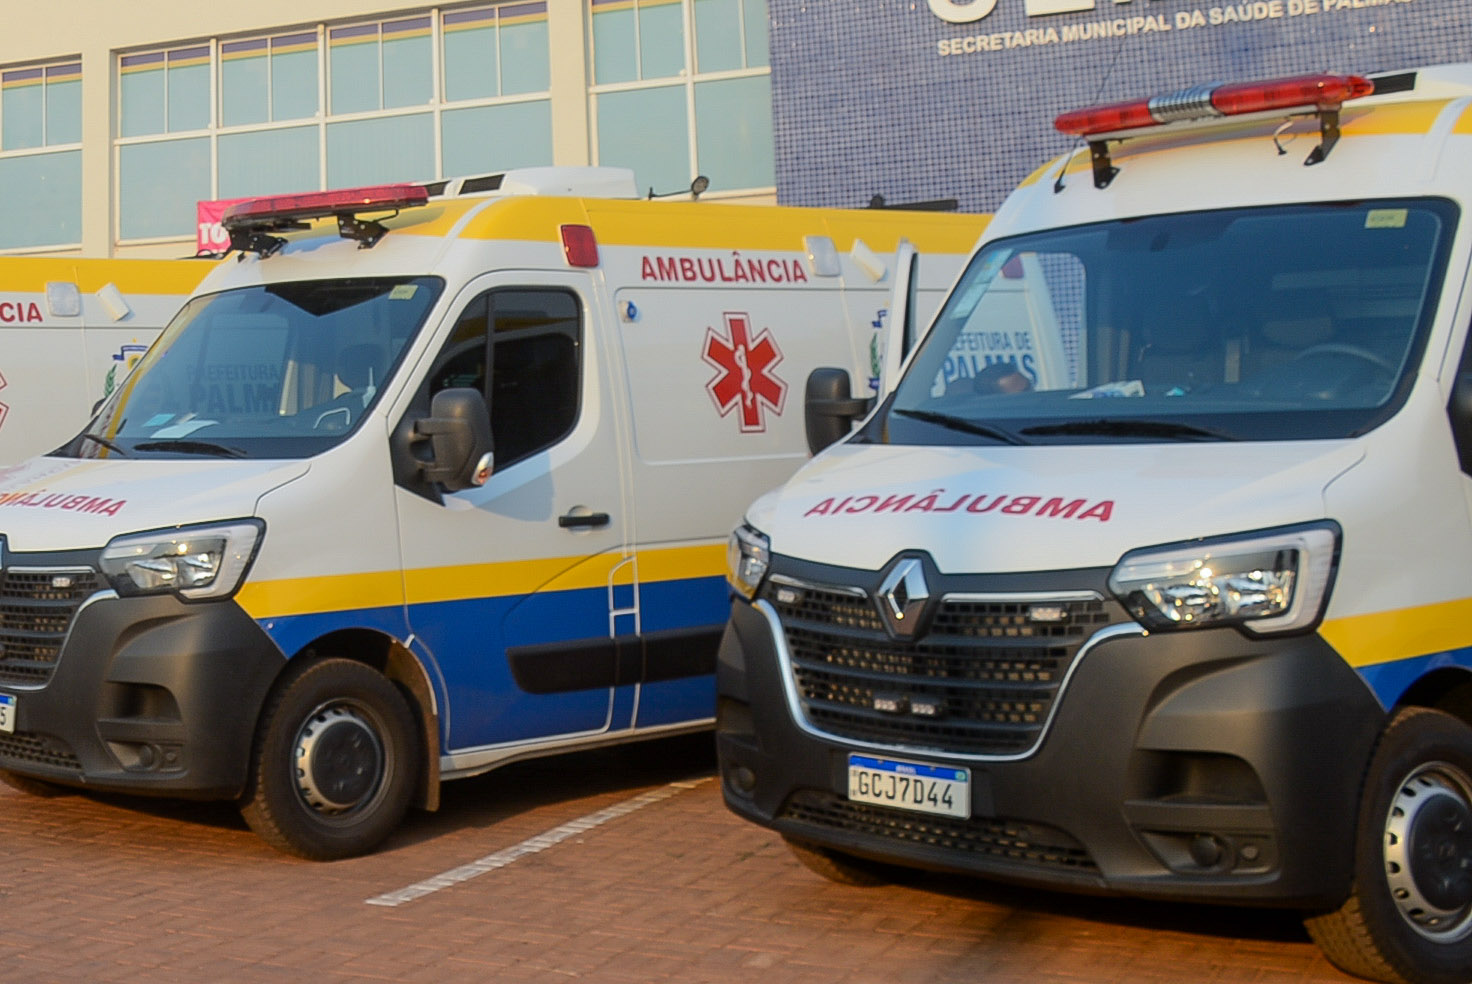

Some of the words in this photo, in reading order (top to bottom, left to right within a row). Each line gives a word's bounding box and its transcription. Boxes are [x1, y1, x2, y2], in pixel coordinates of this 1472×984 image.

[937, 26, 1059, 57] SECRETARIA
[1061, 13, 1173, 44] MUNICIPAL
[1176, 8, 1207, 30] DA
[640, 250, 808, 284] AMBULÂNCIA
[858, 771, 953, 809] GCJ7D44
